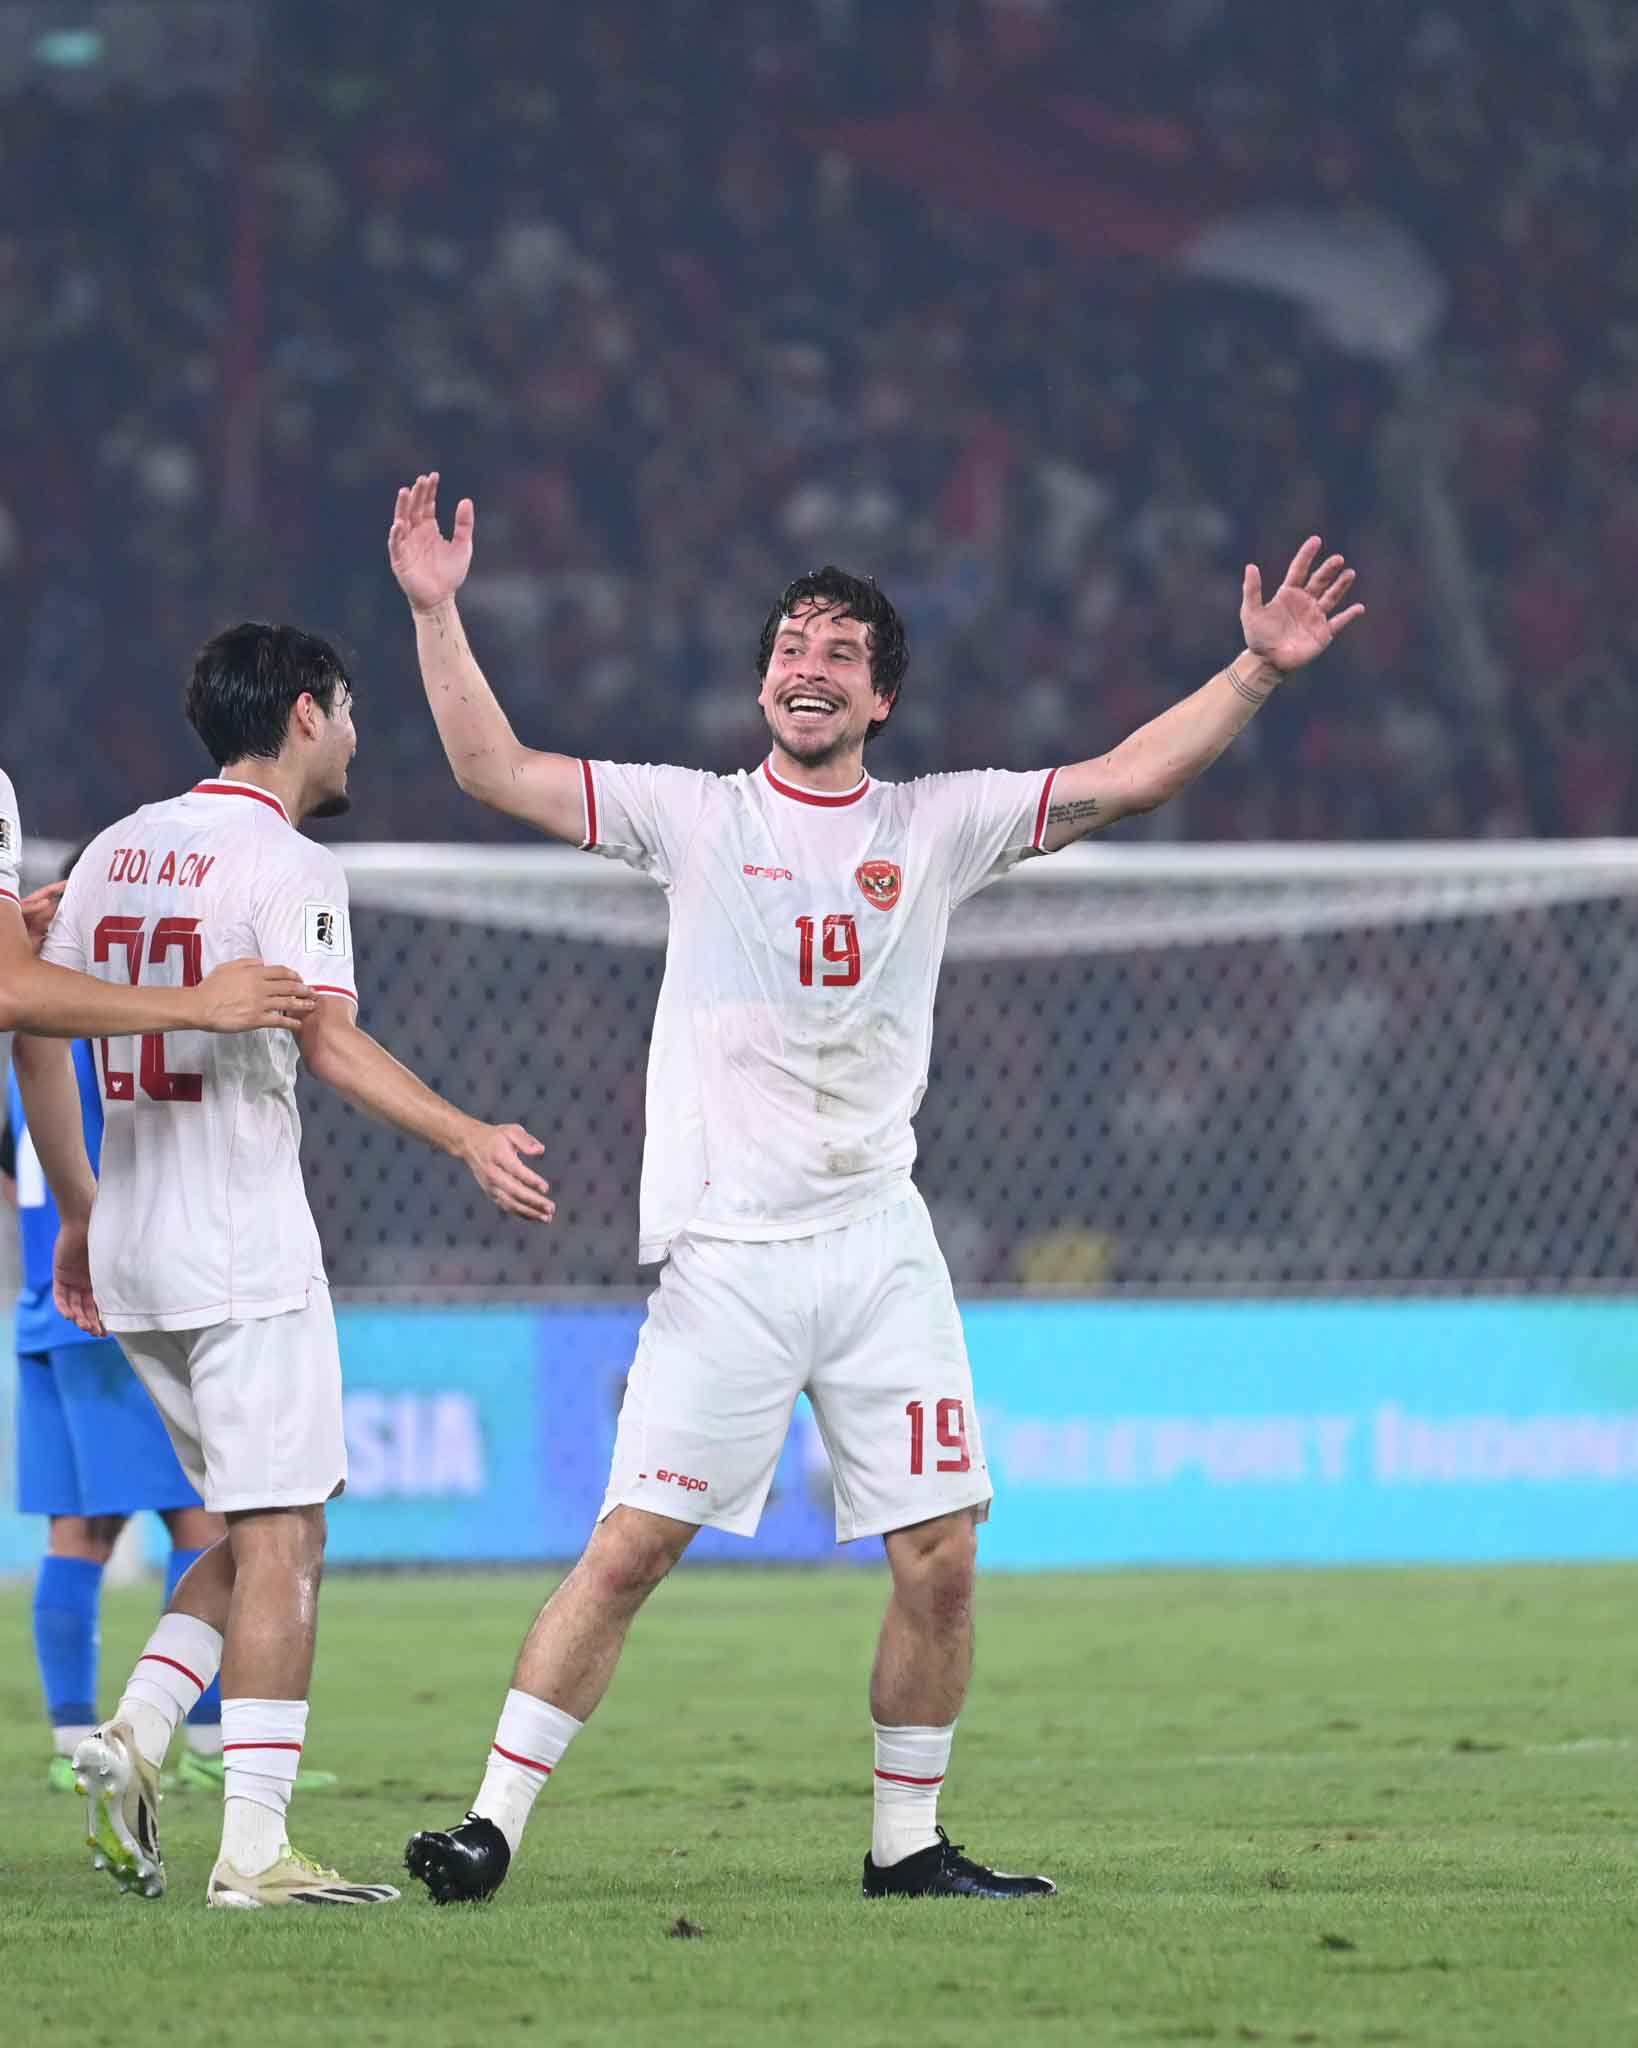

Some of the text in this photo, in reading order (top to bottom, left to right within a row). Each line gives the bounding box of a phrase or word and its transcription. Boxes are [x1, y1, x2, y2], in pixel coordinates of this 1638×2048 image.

[743, 864, 792, 881] erspo
[794, 914, 861, 986] 19
[93, 916, 204, 1102] 22
[906, 1398, 970, 1475] 19
[656, 1469, 708, 1492] erspo
